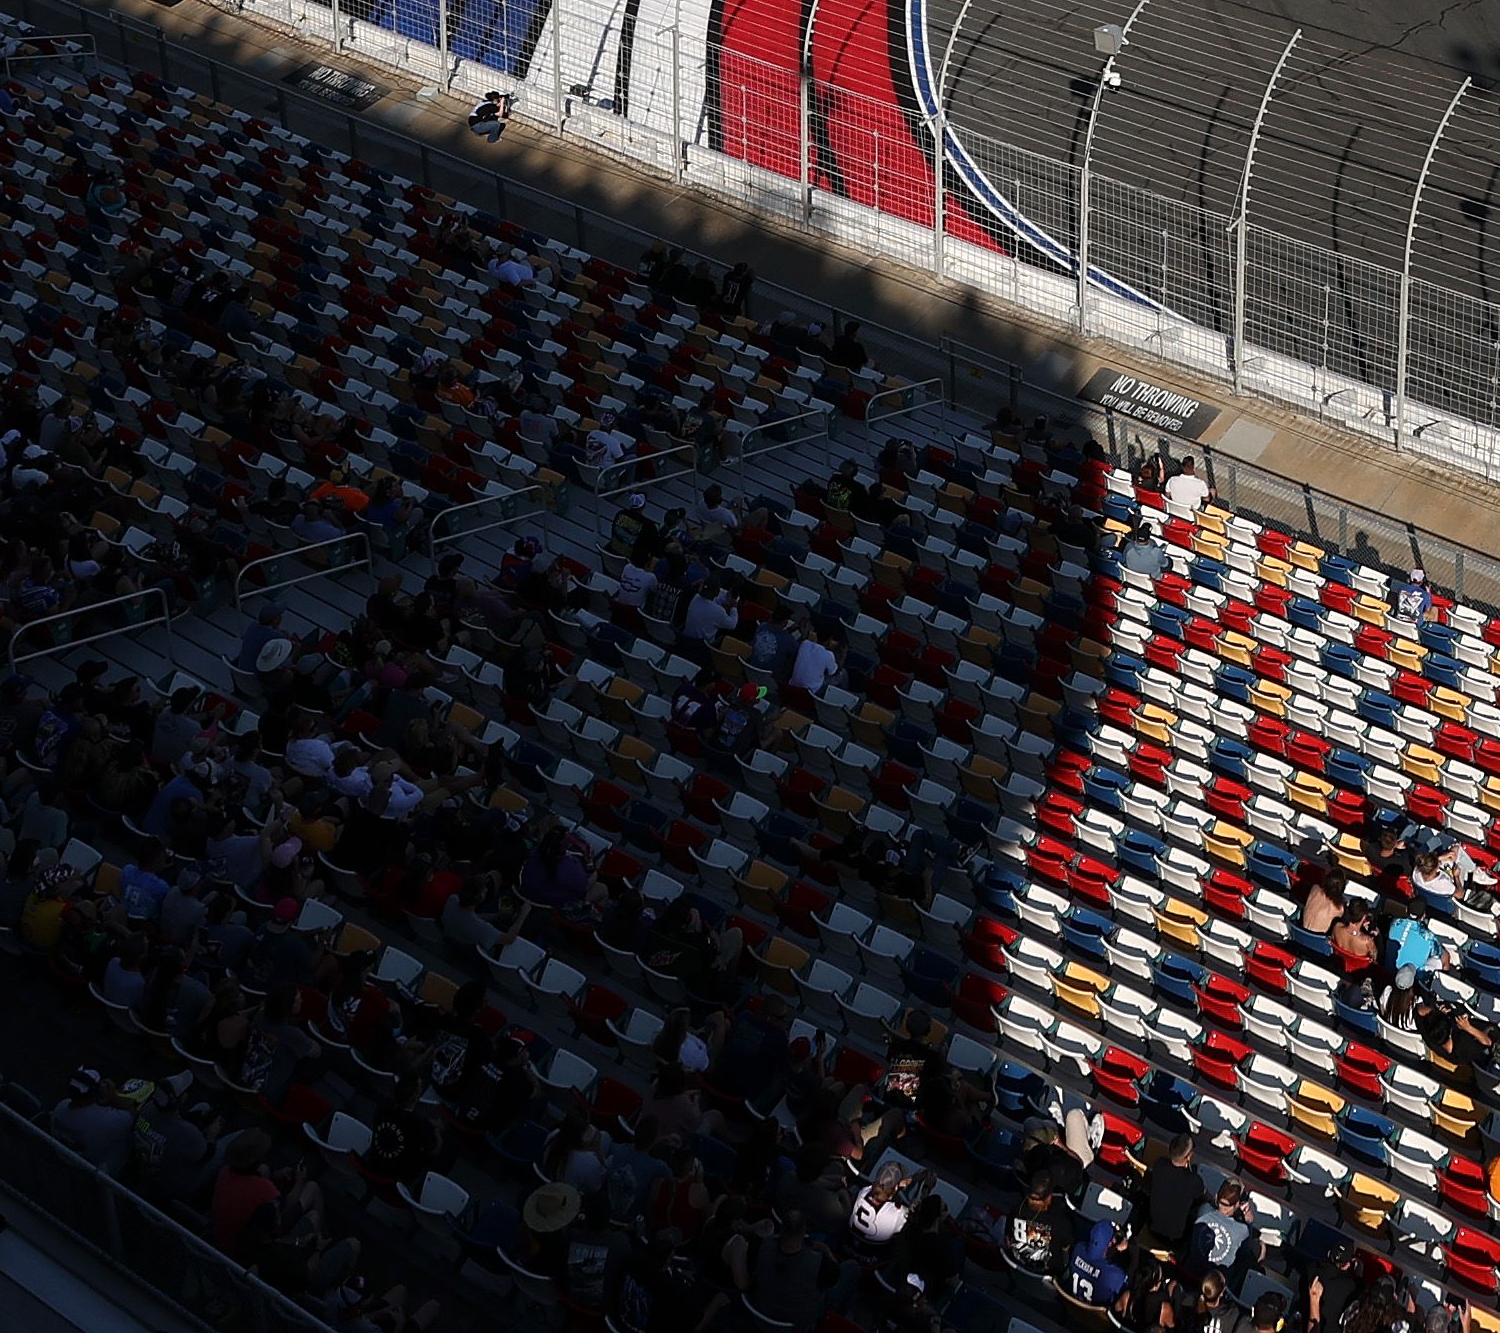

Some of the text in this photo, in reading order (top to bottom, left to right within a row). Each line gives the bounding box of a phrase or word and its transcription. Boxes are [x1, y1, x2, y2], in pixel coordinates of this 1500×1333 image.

[1100, 394, 1183, 432] YOU WILL BE REMOVED
[1110, 375, 1199, 418] NO THROWING
